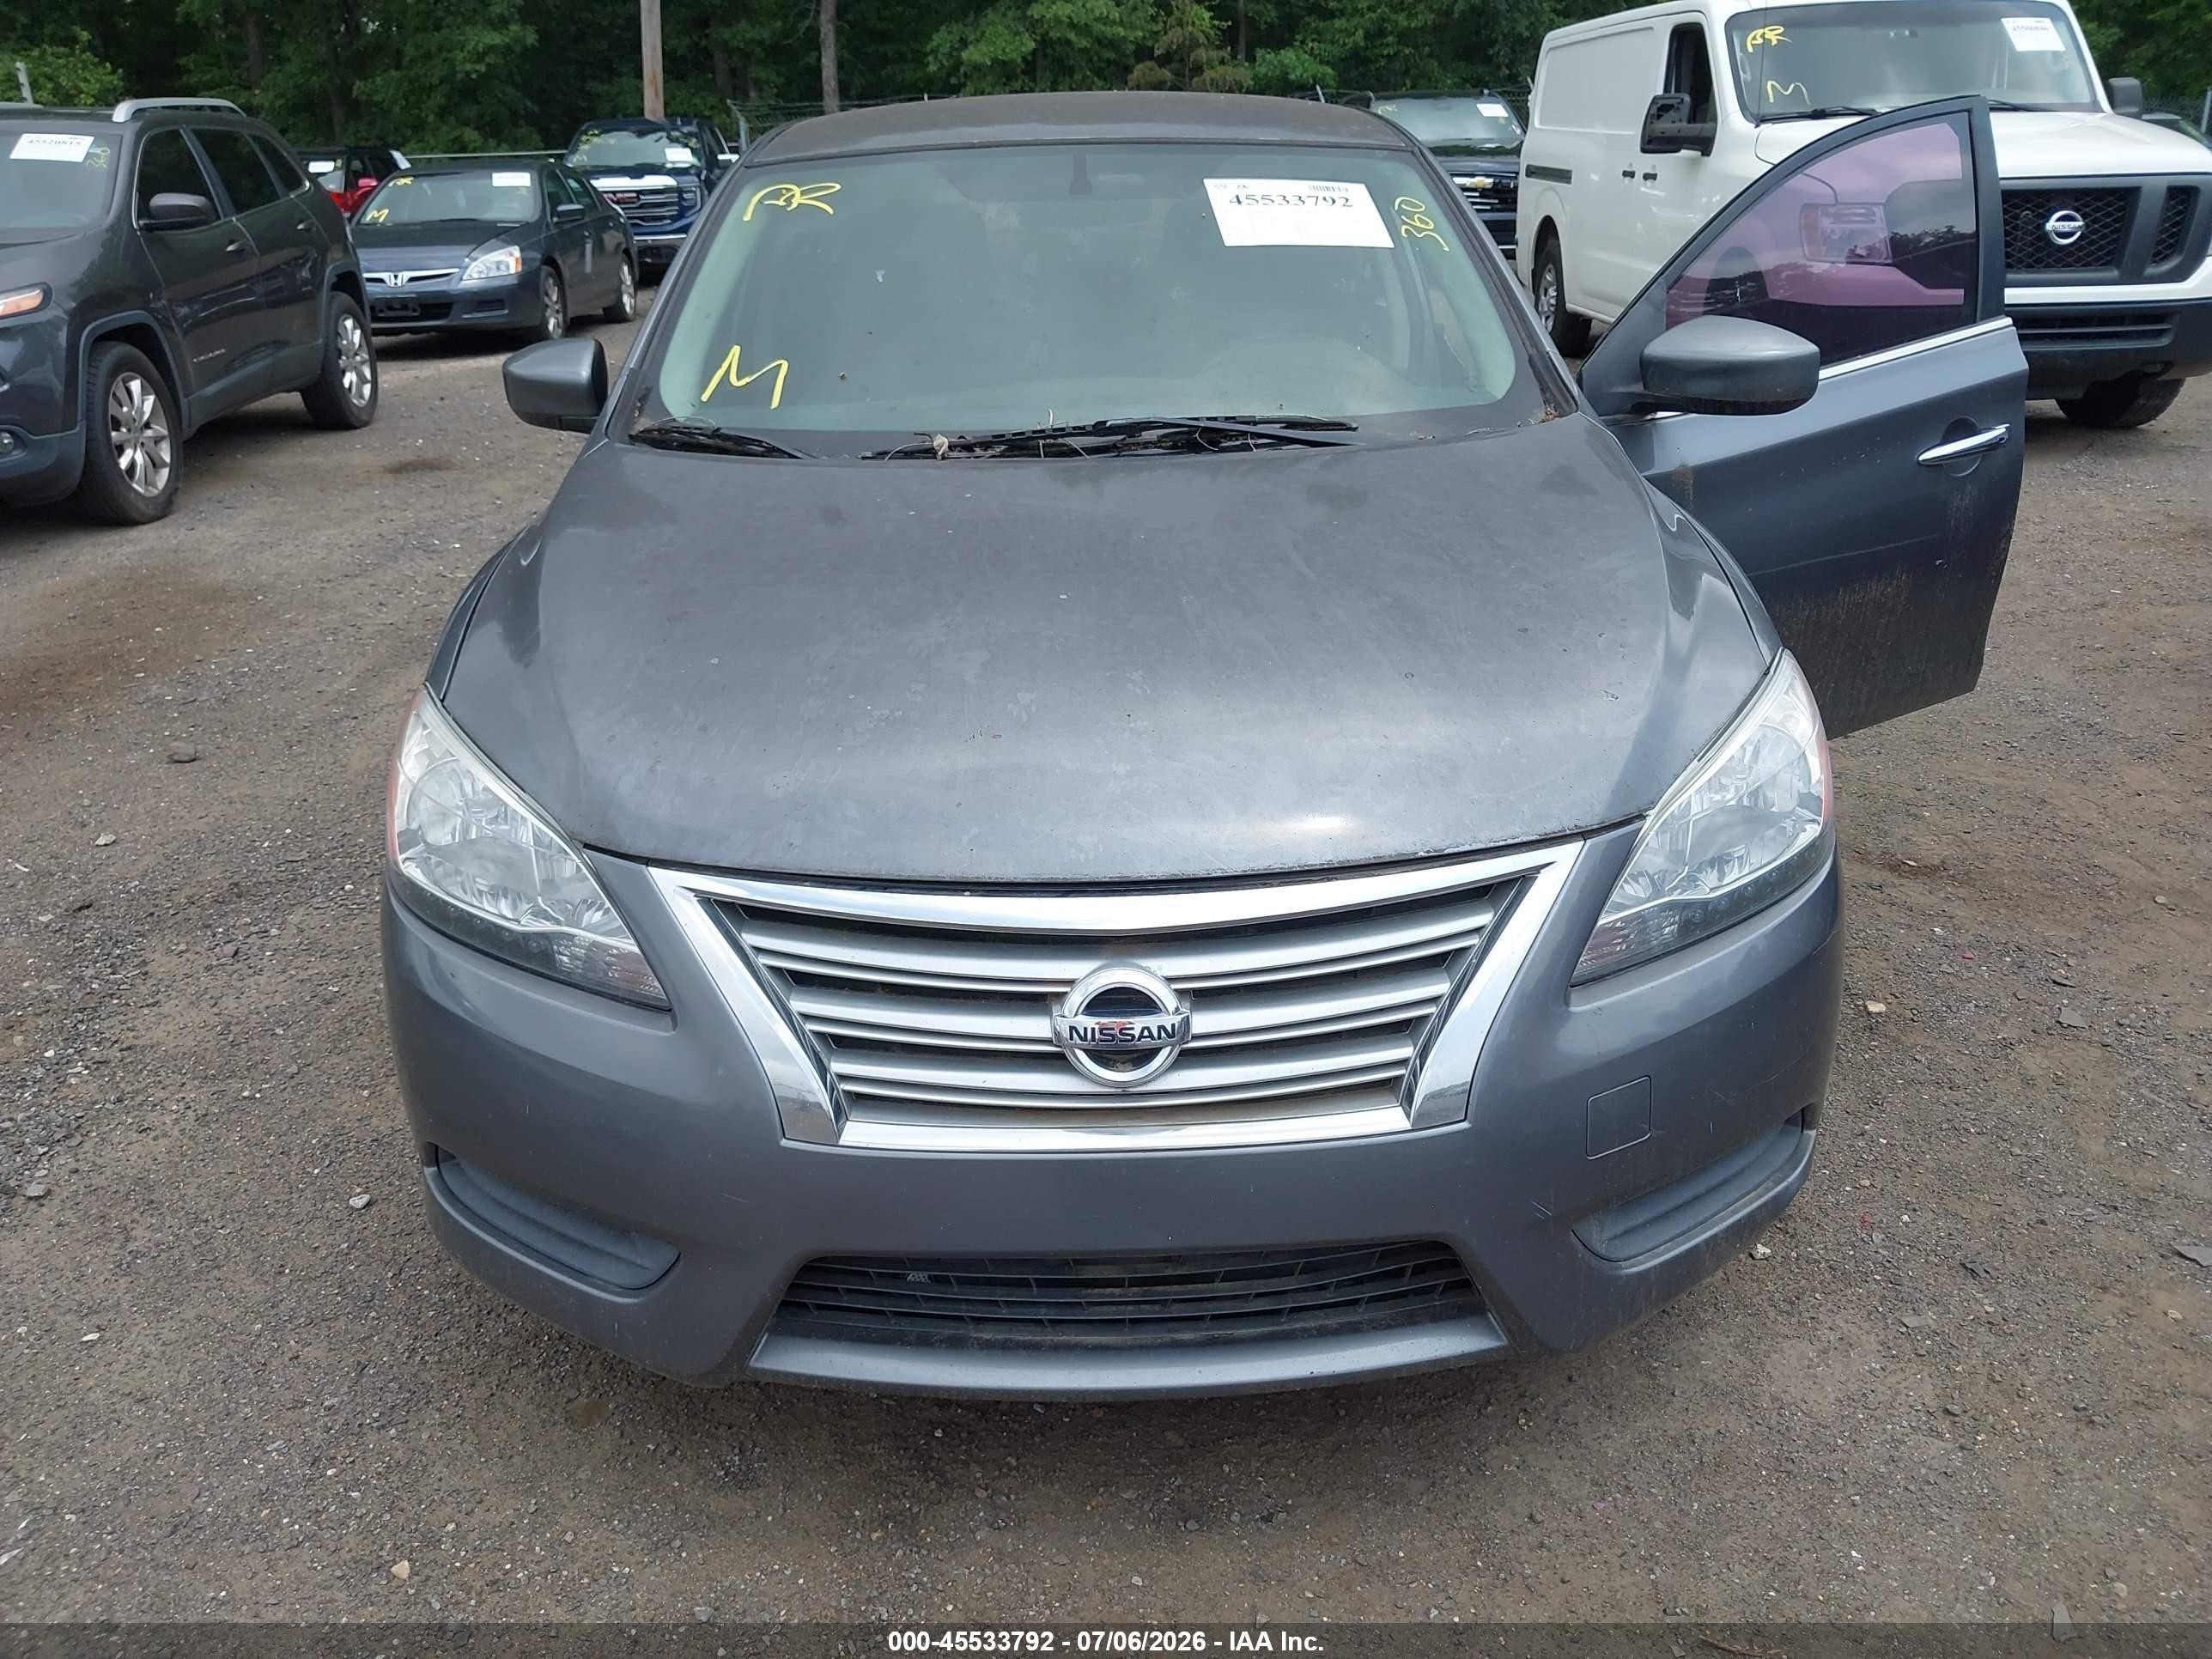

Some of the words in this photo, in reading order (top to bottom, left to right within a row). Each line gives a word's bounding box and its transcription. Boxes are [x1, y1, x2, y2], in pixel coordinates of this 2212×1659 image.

[1767, 80, 1810, 105] M
[1228, 193, 1353, 207] 45533792
[367, 209, 389, 222] M
[1395, 197, 1449, 252] 360
[701, 344, 789, 409] M
[1068, 1023, 1176, 1043] NISSAN
